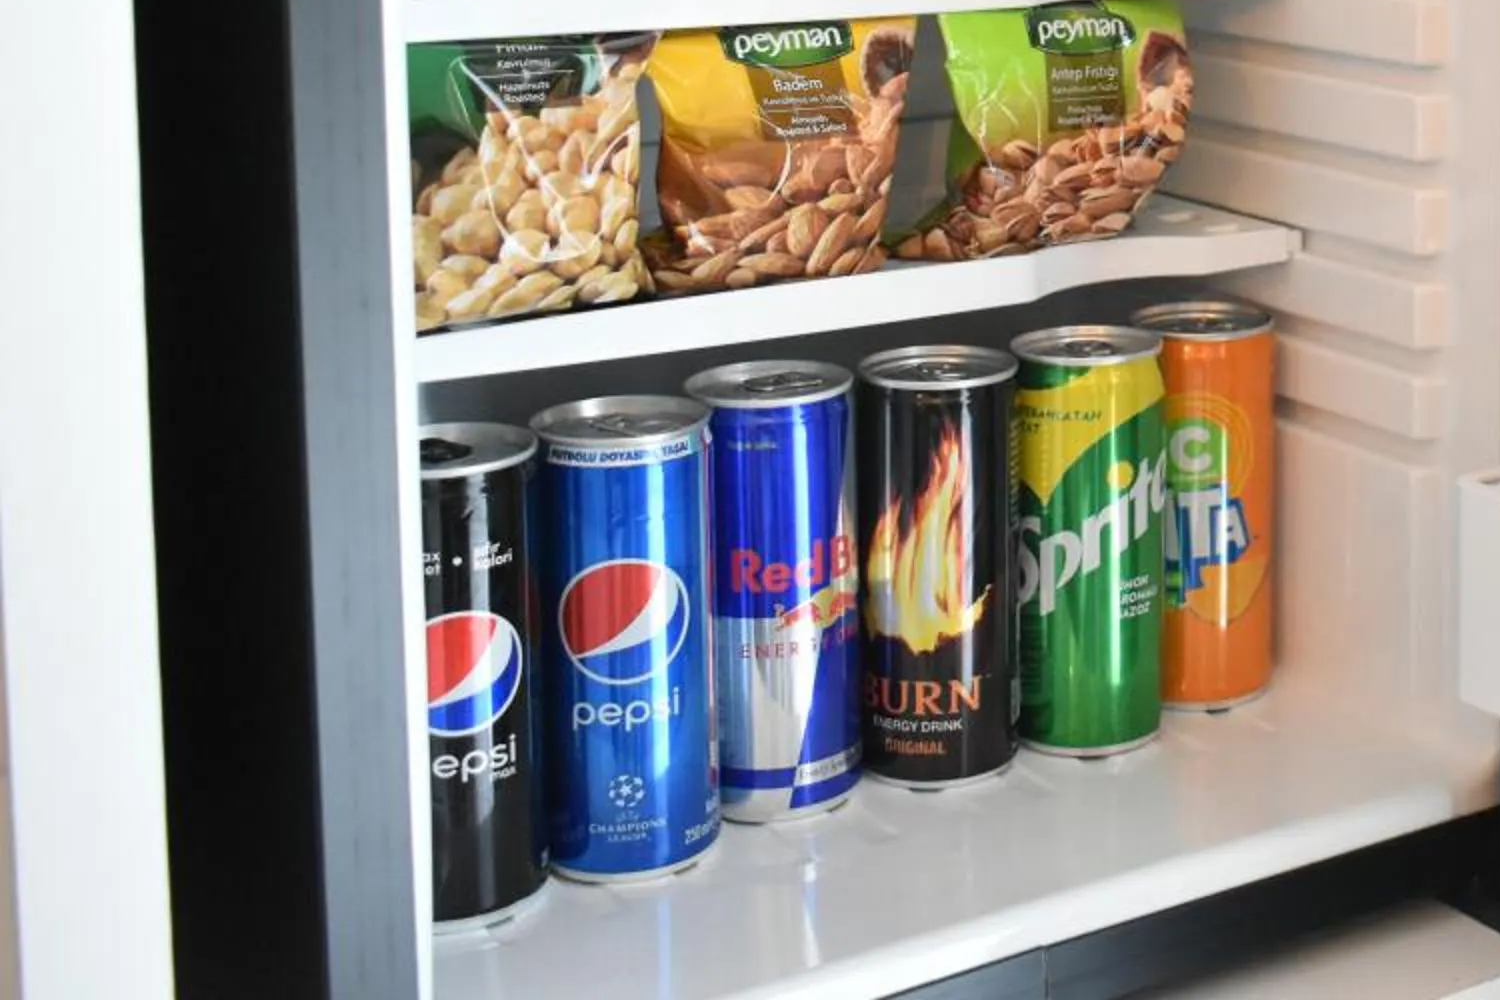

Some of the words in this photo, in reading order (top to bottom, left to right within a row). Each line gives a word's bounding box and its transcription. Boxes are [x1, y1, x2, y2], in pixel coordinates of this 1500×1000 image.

[733, 26, 843, 59] peyman
[1037, 16, 1125, 45] peyman
[1168, 425, 1213, 474] C
[729, 537, 824, 594] Red
[572, 686, 680, 732] pepsi
[873, 713, 918, 733] ENERGY
[920, 717, 964, 733] DRINK
[432, 733, 517, 783] epsi
